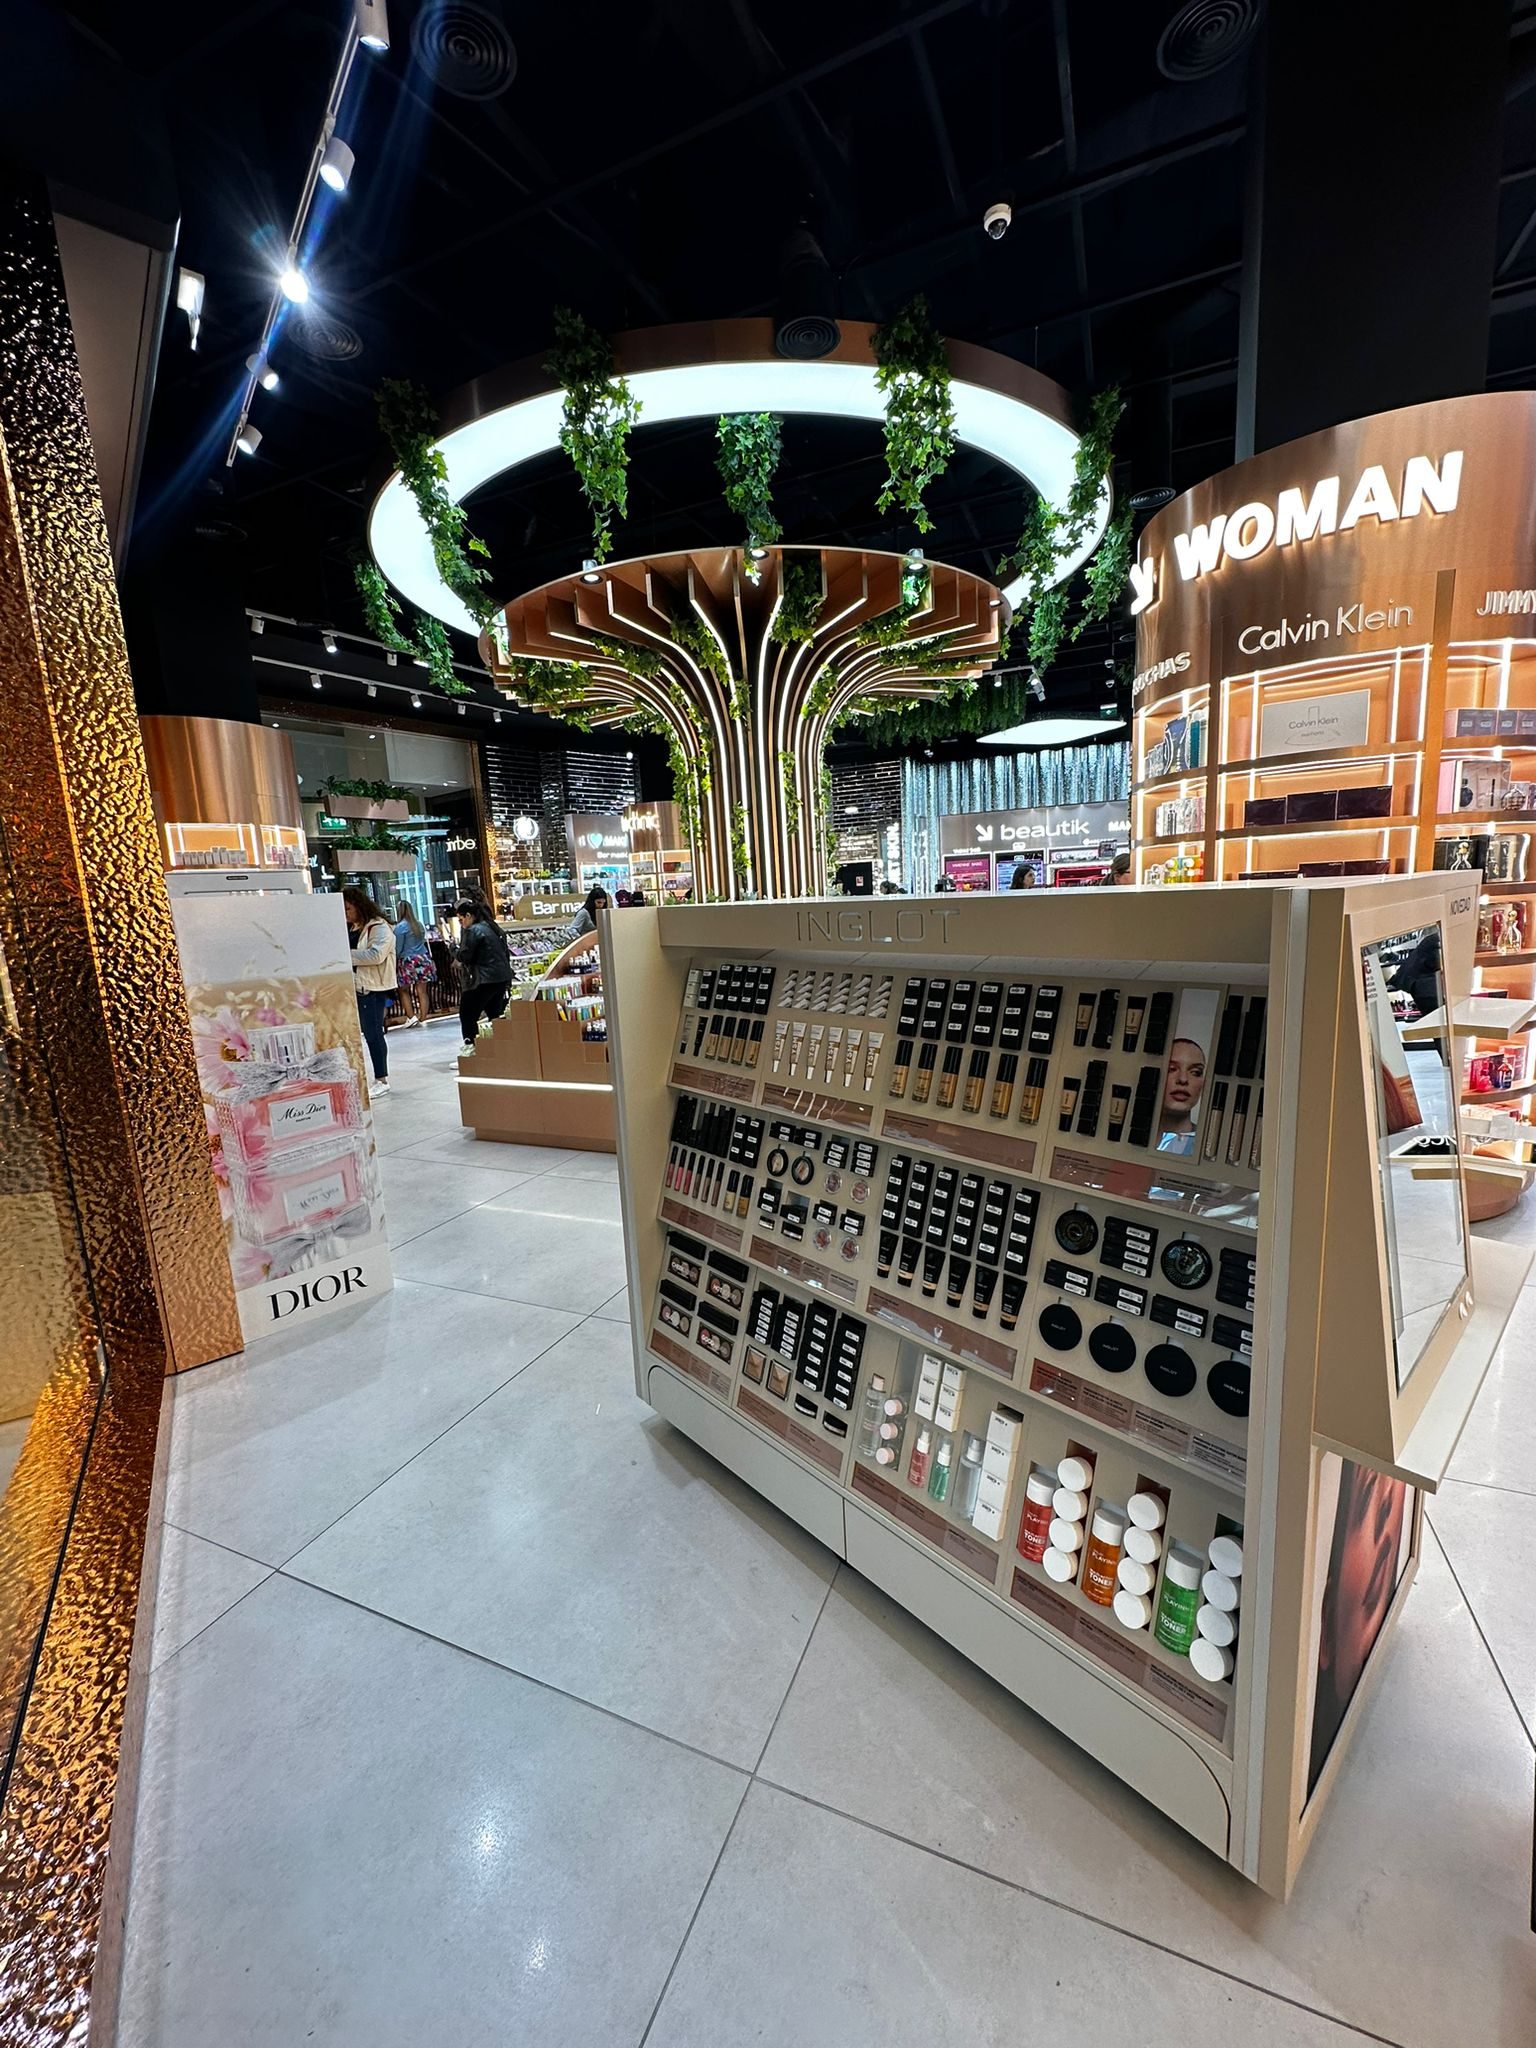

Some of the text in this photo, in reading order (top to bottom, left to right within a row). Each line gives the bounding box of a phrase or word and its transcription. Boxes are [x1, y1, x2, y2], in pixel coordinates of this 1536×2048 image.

[1173, 450, 1464, 581] WOMAN
[1238, 599, 1413, 655] Calvin Klein
[1288, 716, 1338, 730] Calvin Klein
[1000, 819, 1090, 841] beautik
[531, 901, 560, 915] Bar
[796, 908, 961, 943] INGLOT
[277, 1102, 327, 1122] Miss Dior
[268, 1265, 367, 1321] DIOR
[1089, 1572, 1114, 1586] TONER
[1160, 1615, 1187, 1635] TONER
